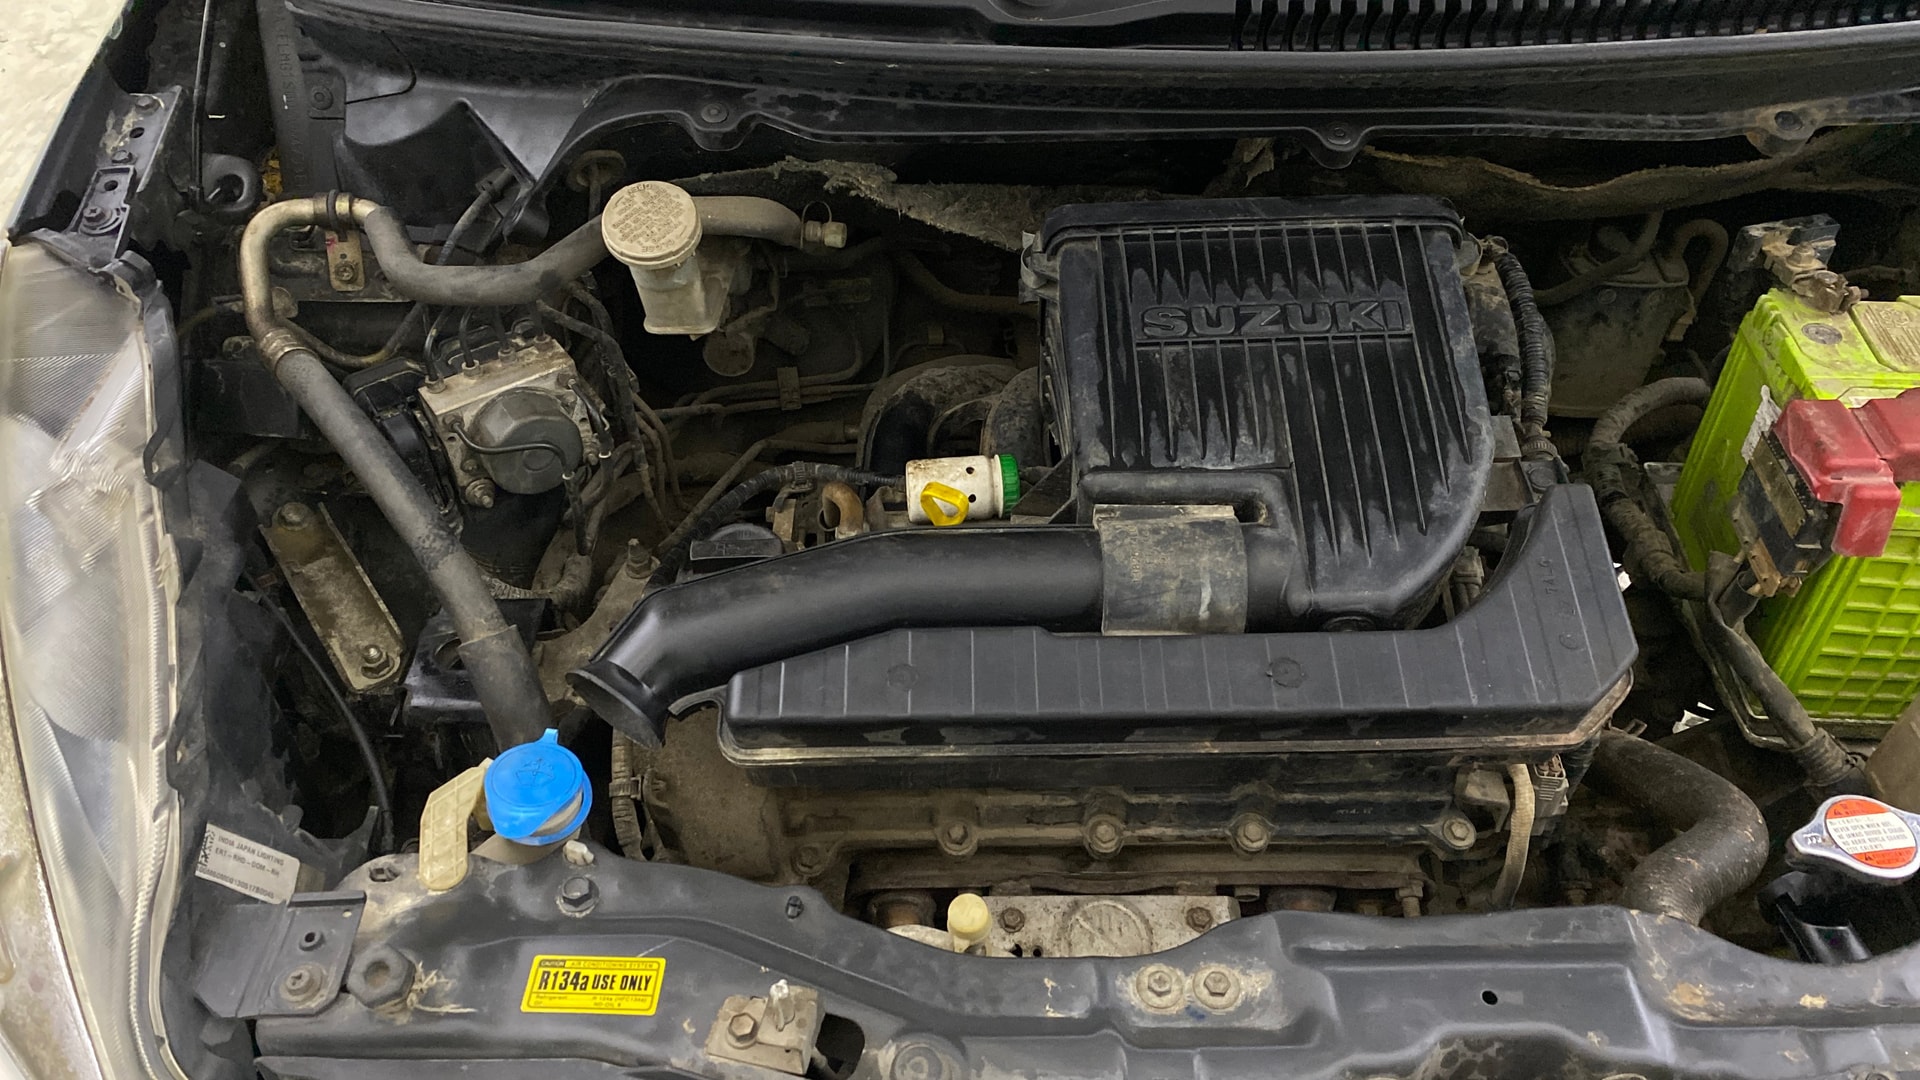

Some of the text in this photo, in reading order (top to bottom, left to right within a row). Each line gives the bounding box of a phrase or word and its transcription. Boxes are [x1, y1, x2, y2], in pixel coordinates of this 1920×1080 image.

[1143, 301, 1404, 338] SUZUKI
[218, 836, 284, 866] INDIA JAPAN LIGHTING
[538, 970, 652, 991] R134a USE ONLY
